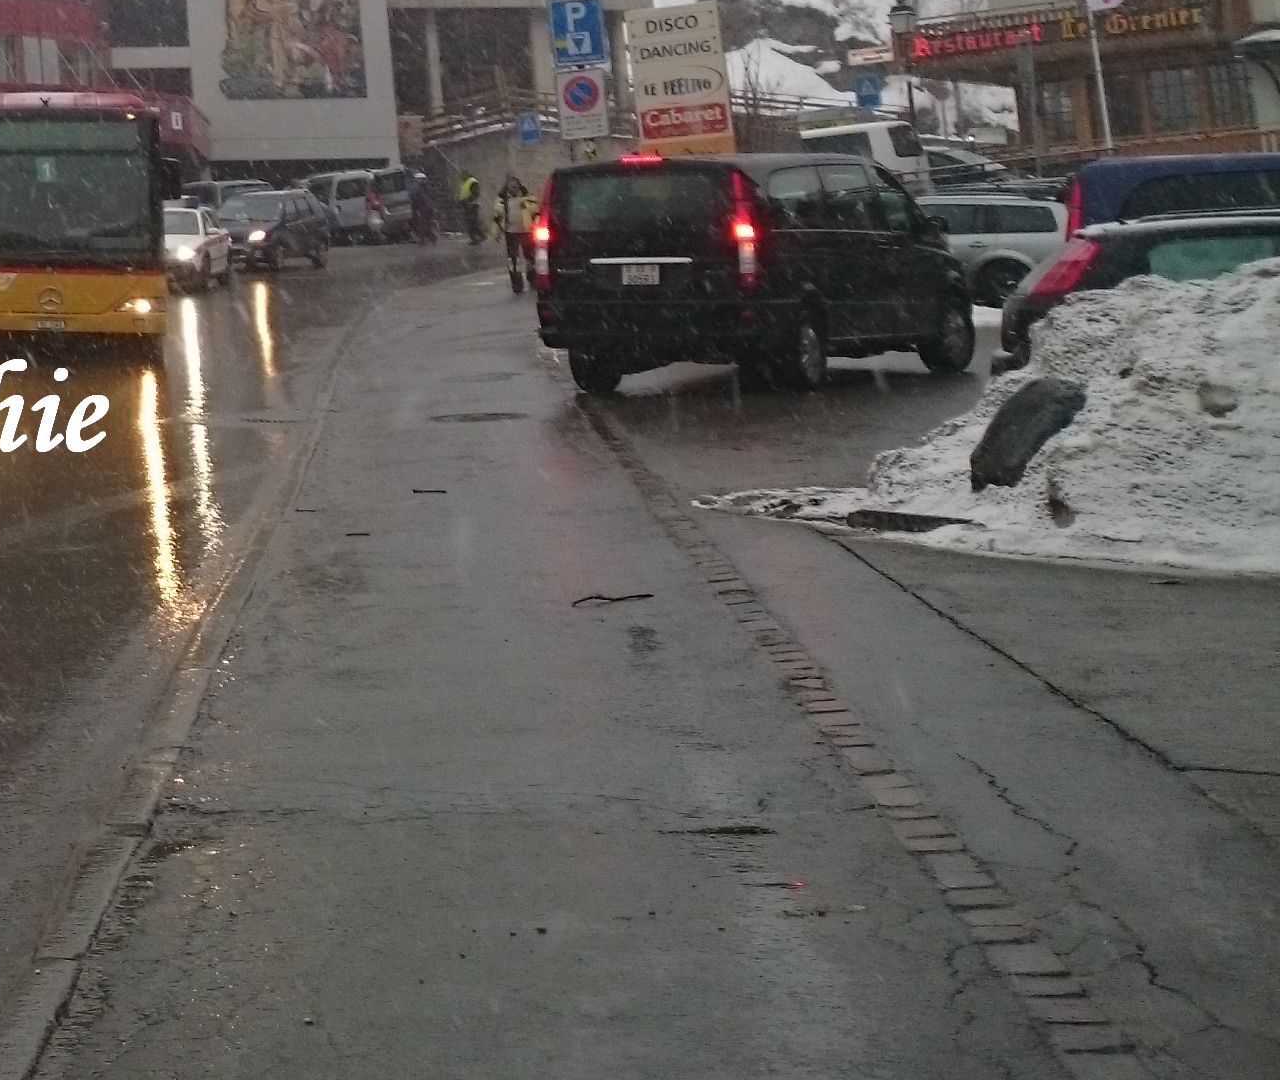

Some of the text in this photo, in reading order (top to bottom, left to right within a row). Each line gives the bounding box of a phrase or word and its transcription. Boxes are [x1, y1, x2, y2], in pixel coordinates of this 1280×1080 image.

[565, 2, 586, 32] P
[646, 15, 698, 34] DISCO
[640, 40, 712, 60] DANCING
[911, 23, 1042, 59] Restaurat
[644, 83, 657, 96] LE
[645, 106, 724, 126] Cabaret
